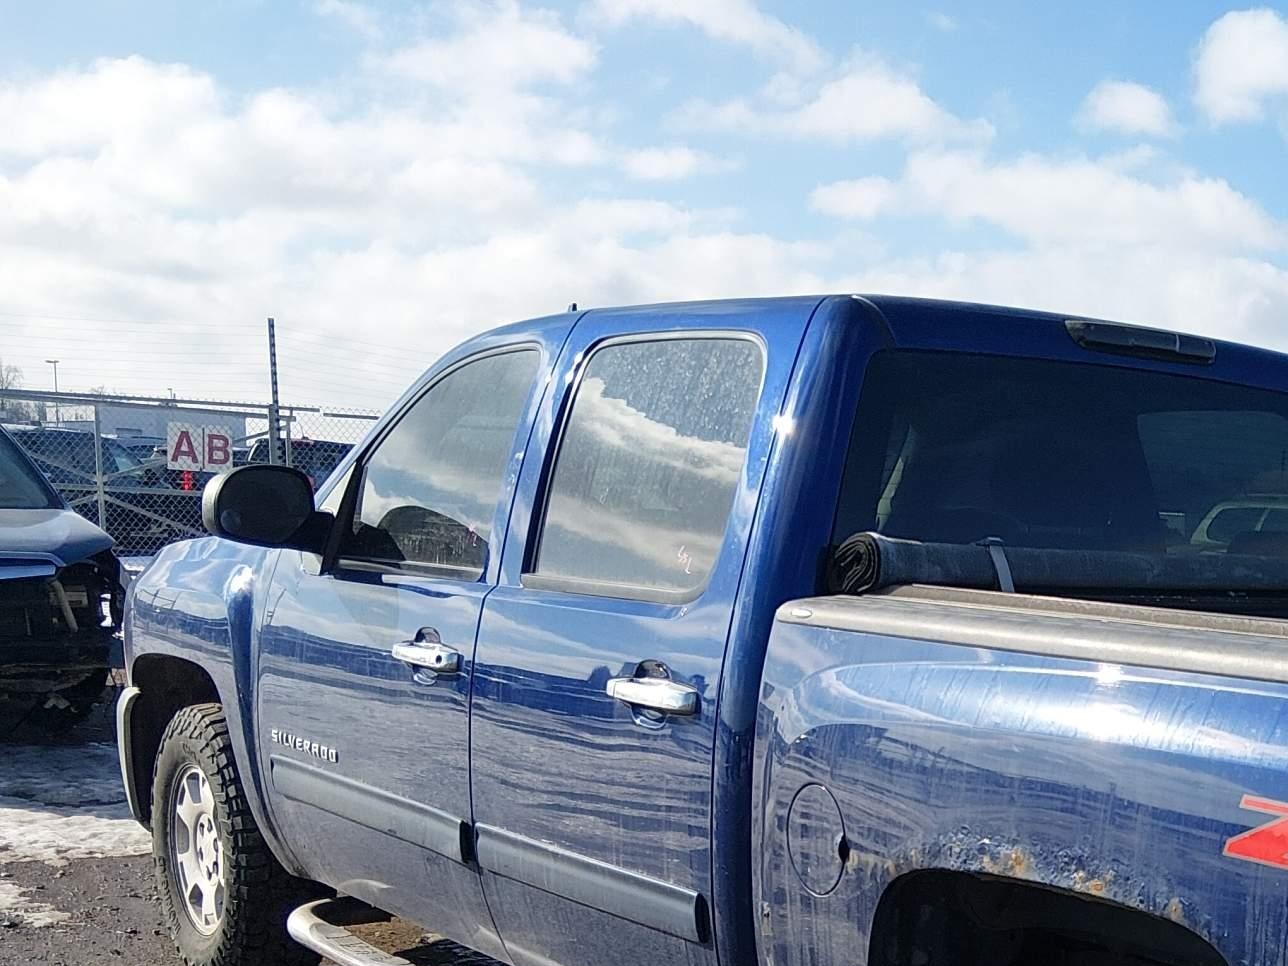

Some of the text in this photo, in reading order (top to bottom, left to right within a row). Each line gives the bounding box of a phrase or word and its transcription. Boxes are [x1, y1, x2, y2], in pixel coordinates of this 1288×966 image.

[171, 430, 230, 465] A B
[271, 729, 337, 763] SILVERADO
